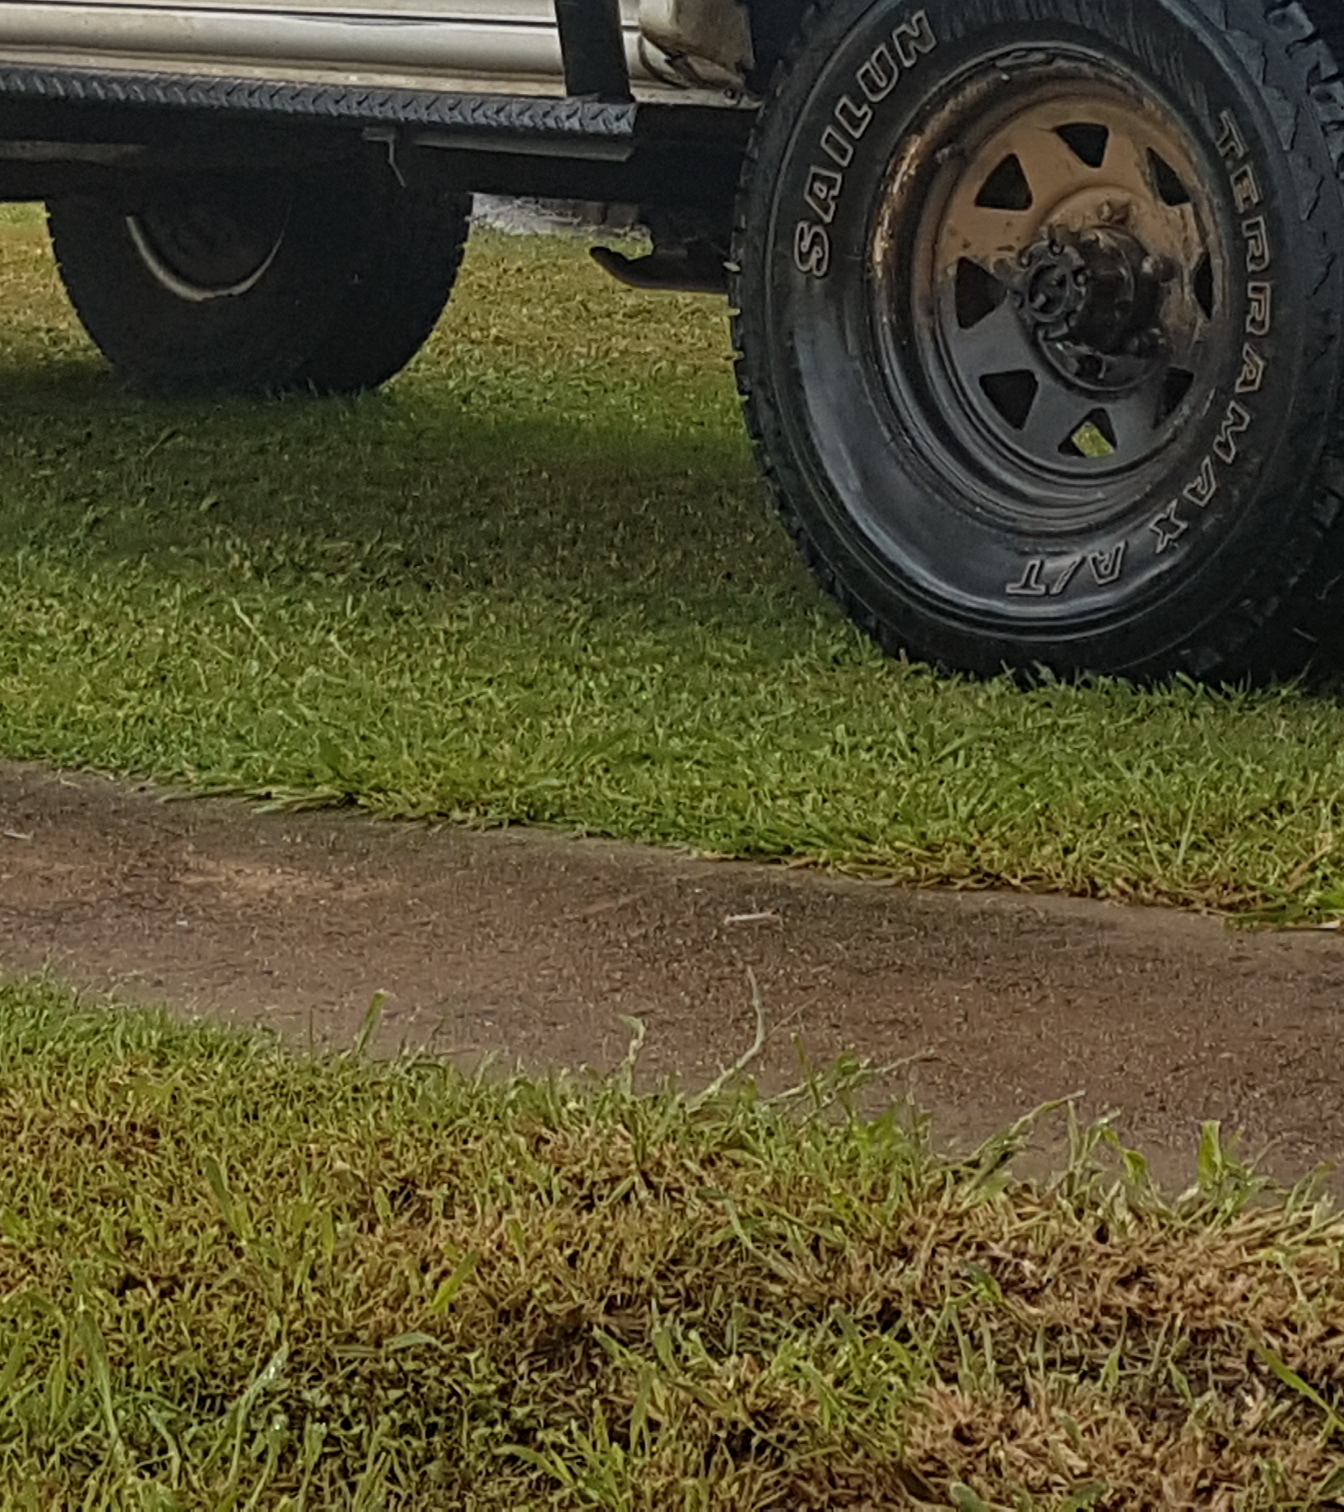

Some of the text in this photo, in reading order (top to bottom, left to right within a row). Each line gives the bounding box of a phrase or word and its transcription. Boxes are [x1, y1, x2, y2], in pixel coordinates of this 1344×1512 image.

[793, 8, 938, 278] SAILUN
[1006, 108, 1272, 596] TERRAMAX A/T
